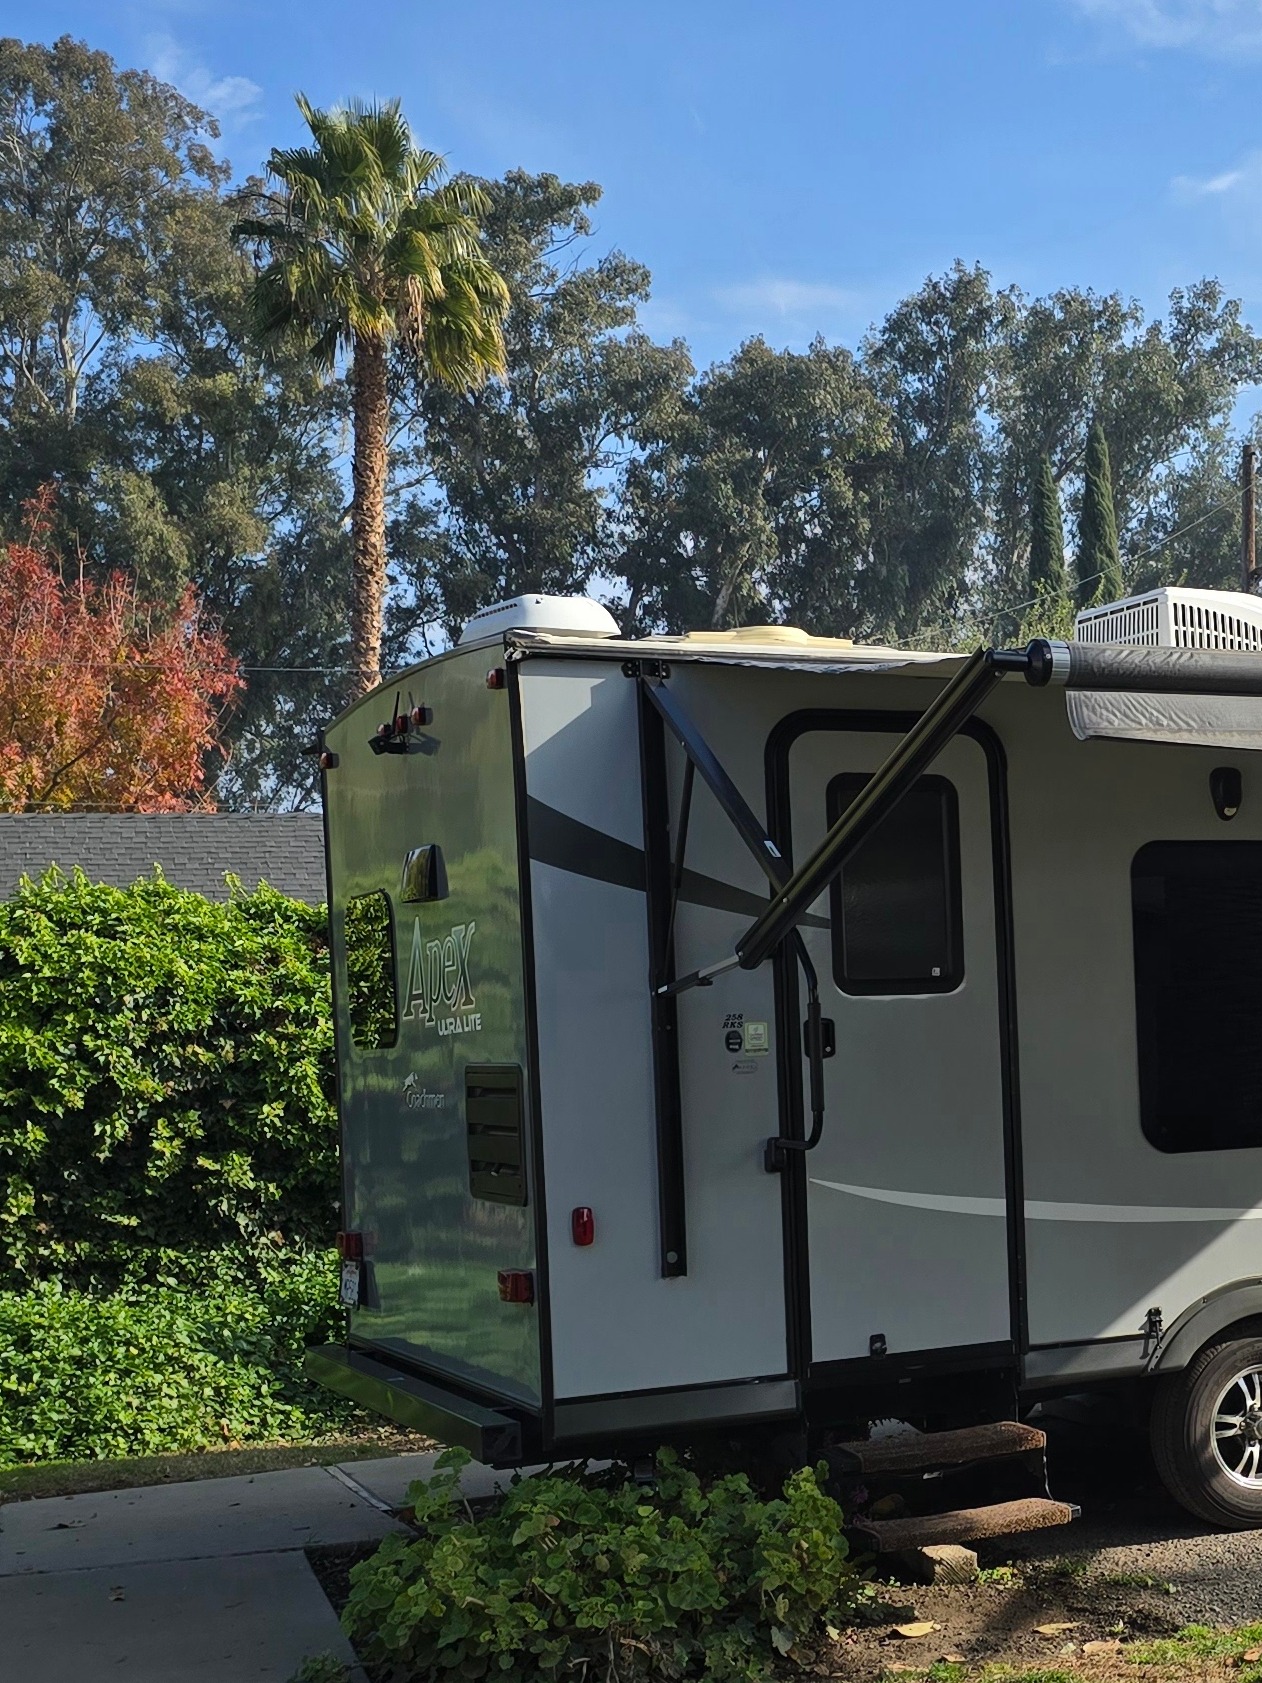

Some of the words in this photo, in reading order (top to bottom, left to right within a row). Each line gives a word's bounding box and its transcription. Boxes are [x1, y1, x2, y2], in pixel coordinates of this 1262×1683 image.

[725, 1013, 743, 1021] 258
[463, 1013, 481, 1032] LITE
[722, 1021, 743, 1029] RKS
